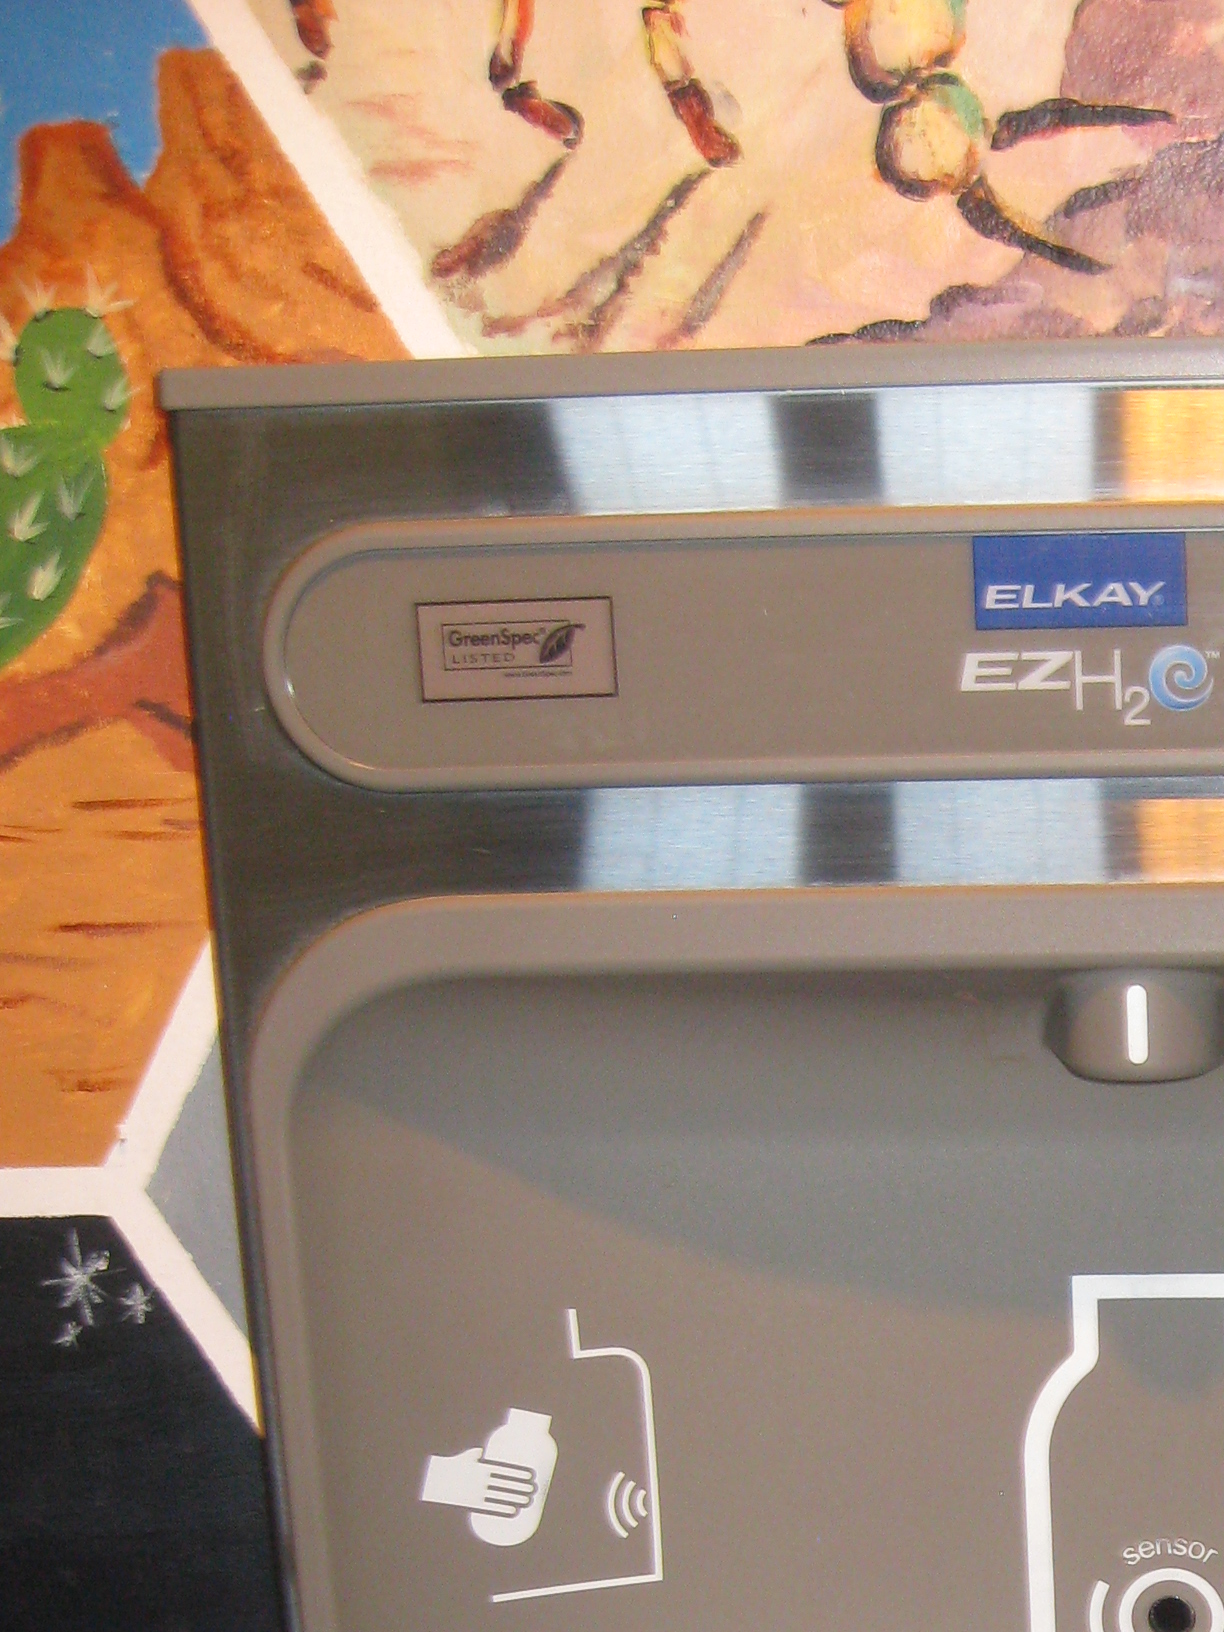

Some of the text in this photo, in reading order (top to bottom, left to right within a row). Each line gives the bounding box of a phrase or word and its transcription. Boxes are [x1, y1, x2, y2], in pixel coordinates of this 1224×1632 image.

[985, 581, 1167, 610] ELKAY
[451, 652, 516, 665] LISTED
[1122, 1537, 1219, 1566] sensor
